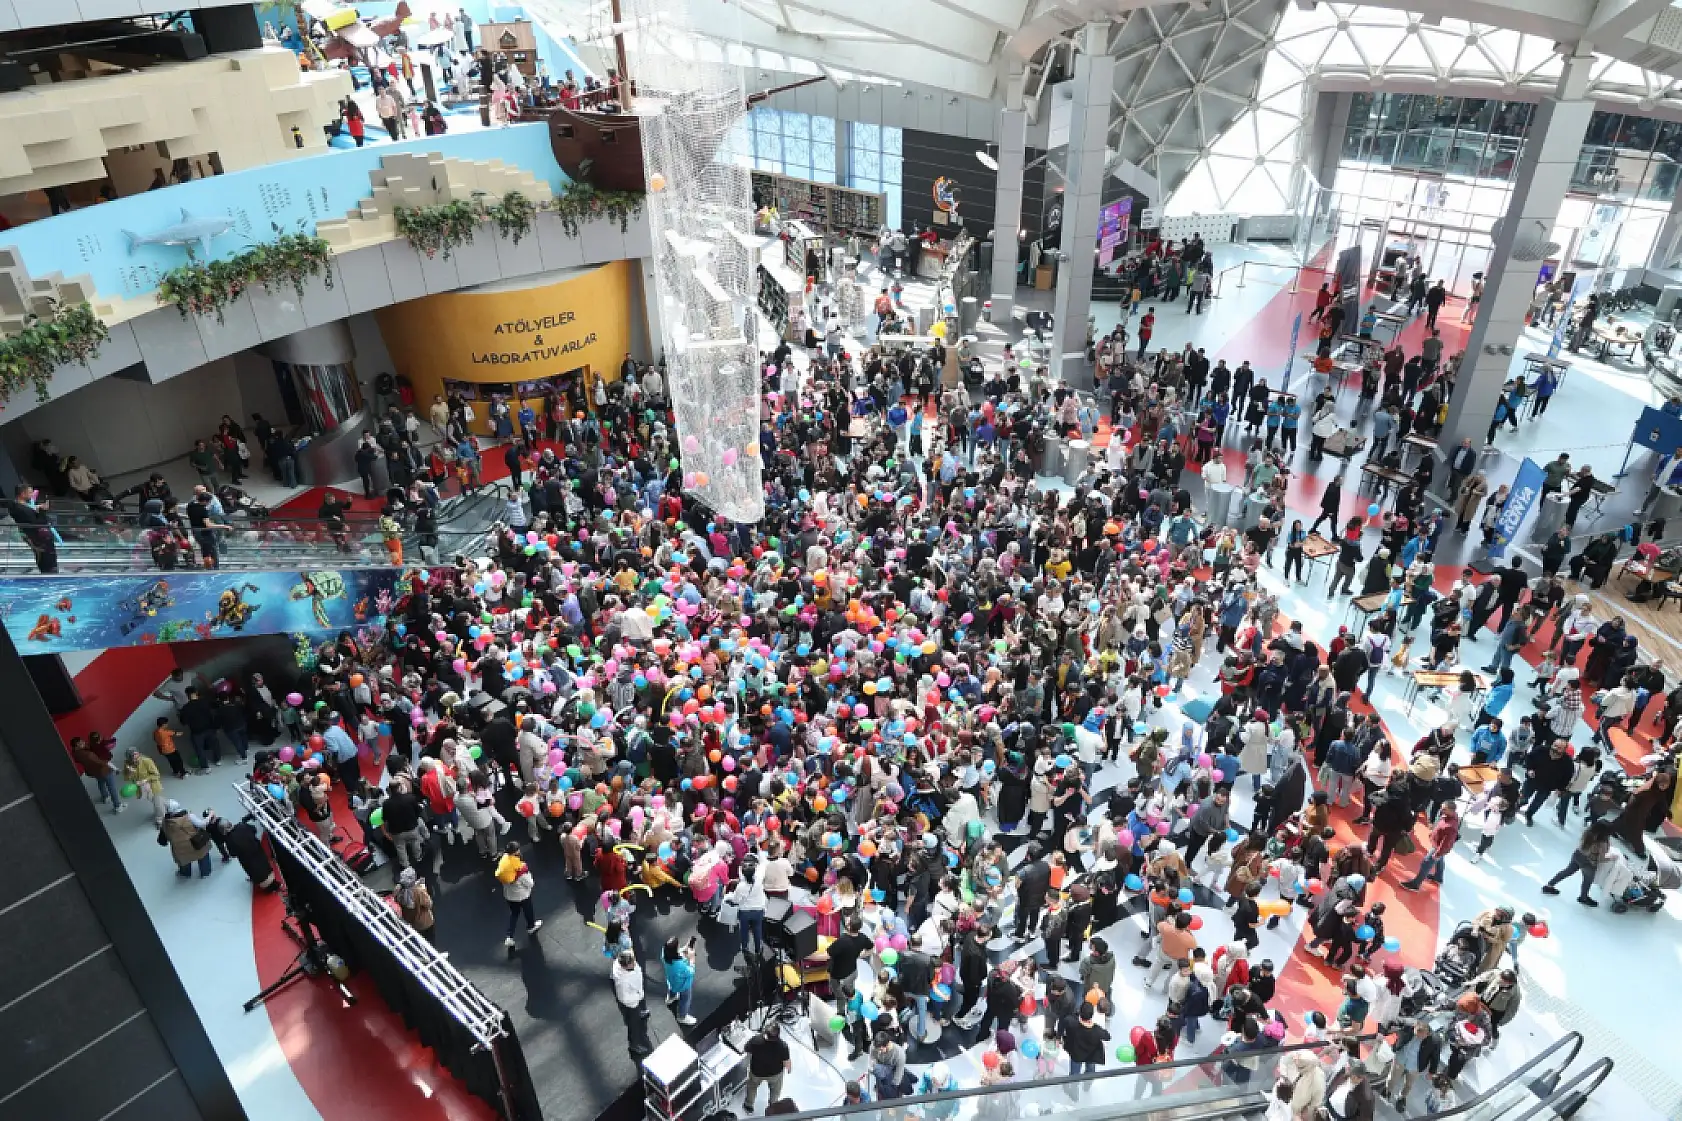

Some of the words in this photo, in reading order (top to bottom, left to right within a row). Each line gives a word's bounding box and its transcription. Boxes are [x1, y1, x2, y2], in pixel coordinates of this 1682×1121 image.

[495, 312, 575, 334] ATÖLYELER
[472, 333, 597, 364] LABORATUVARLAR
[534, 334, 544, 346] &
[1504, 486, 1535, 534] KONYA
